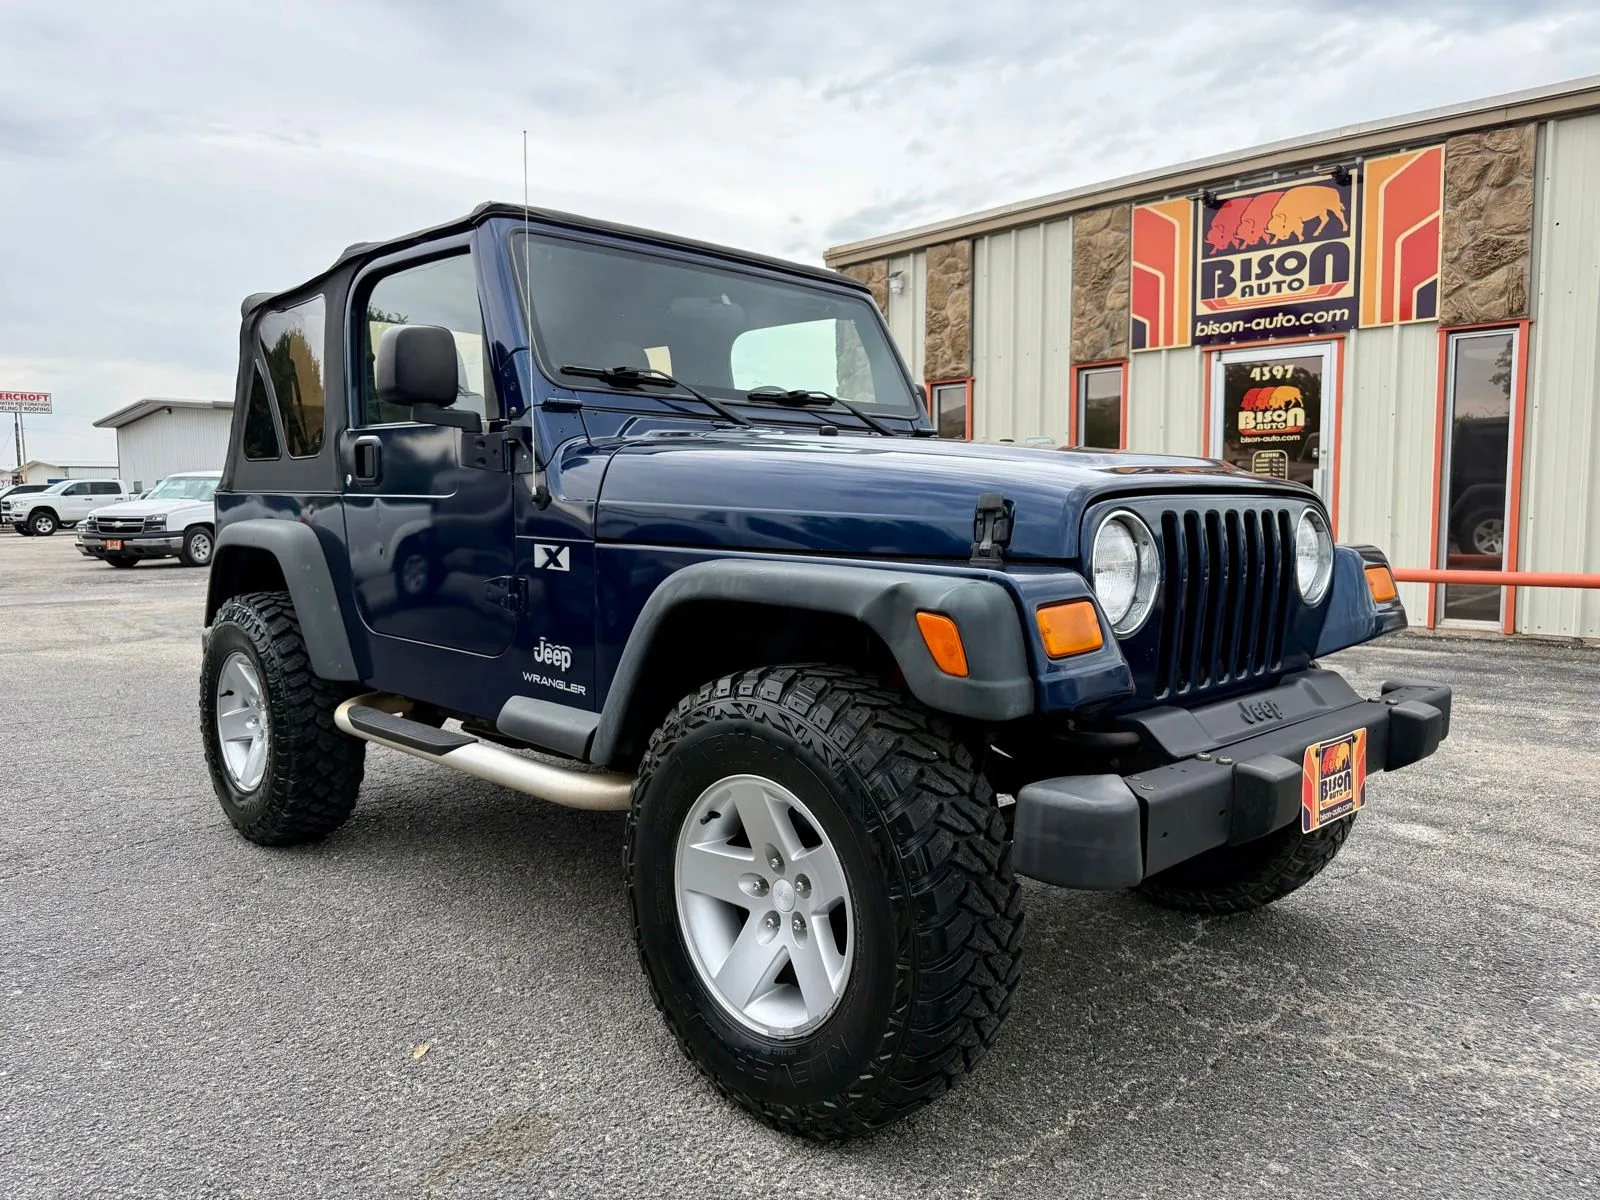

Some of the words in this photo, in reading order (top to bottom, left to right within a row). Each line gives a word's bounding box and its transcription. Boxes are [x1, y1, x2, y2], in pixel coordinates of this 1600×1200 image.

[1240, 277, 1305, 298] AUTO
[1195, 307, 1349, 337] bison-auto.com
[1250, 364, 1295, 381] 4397
[1256, 421, 1286, 430] AUTO
[1240, 434, 1300, 444] bison-auto.com
[533, 636, 573, 672] Jeep
[522, 671, 586, 696] WRANGLER
[1329, 789, 1344, 800] AUTO
[1319, 802, 1353, 822] bison-auto.com
